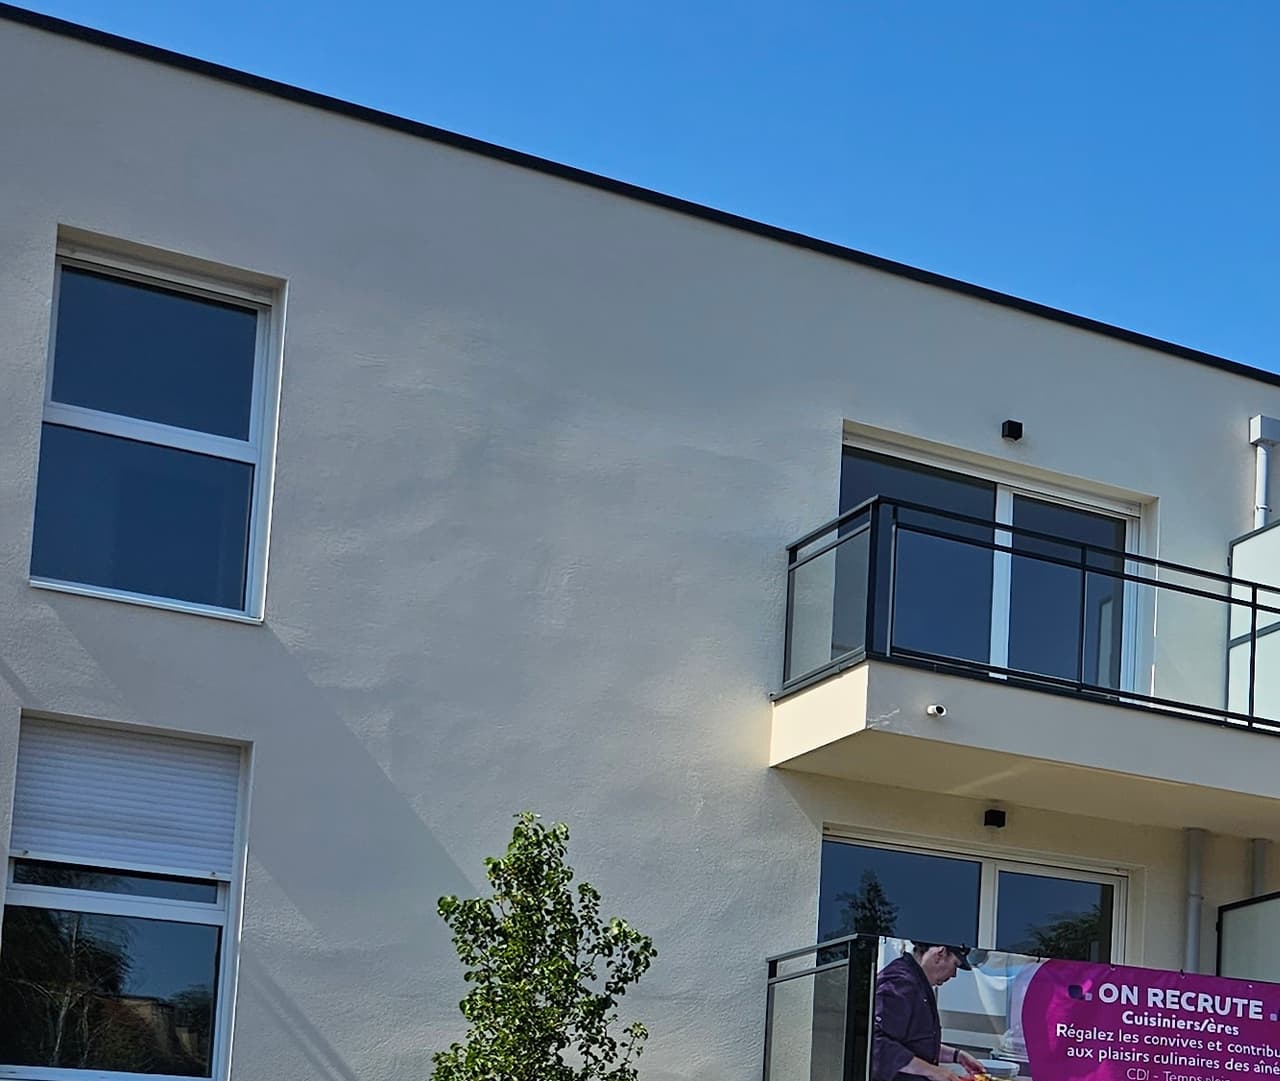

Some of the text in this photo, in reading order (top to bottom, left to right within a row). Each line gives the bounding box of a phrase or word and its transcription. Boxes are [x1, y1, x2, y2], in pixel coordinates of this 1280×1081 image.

[1098, 982, 1264, 1020] ON RECRUTE
[1122, 1010, 1239, 1036] Cuisiniers/ères
[1056, 1023, 1115, 1042] Régalez
[1119, 1029, 1139, 1043] les
[1144, 1034, 1203, 1049] convives
[1207, 1039, 1223, 1052] et
[1067, 1046, 1094, 1059] aux
[1098, 1046, 1150, 1063] plaisirs
[1153, 1051, 1220, 1069] culinaires
[1224, 1058, 1250, 1072] des
[1126, 1068, 1150, 1081] CDI
